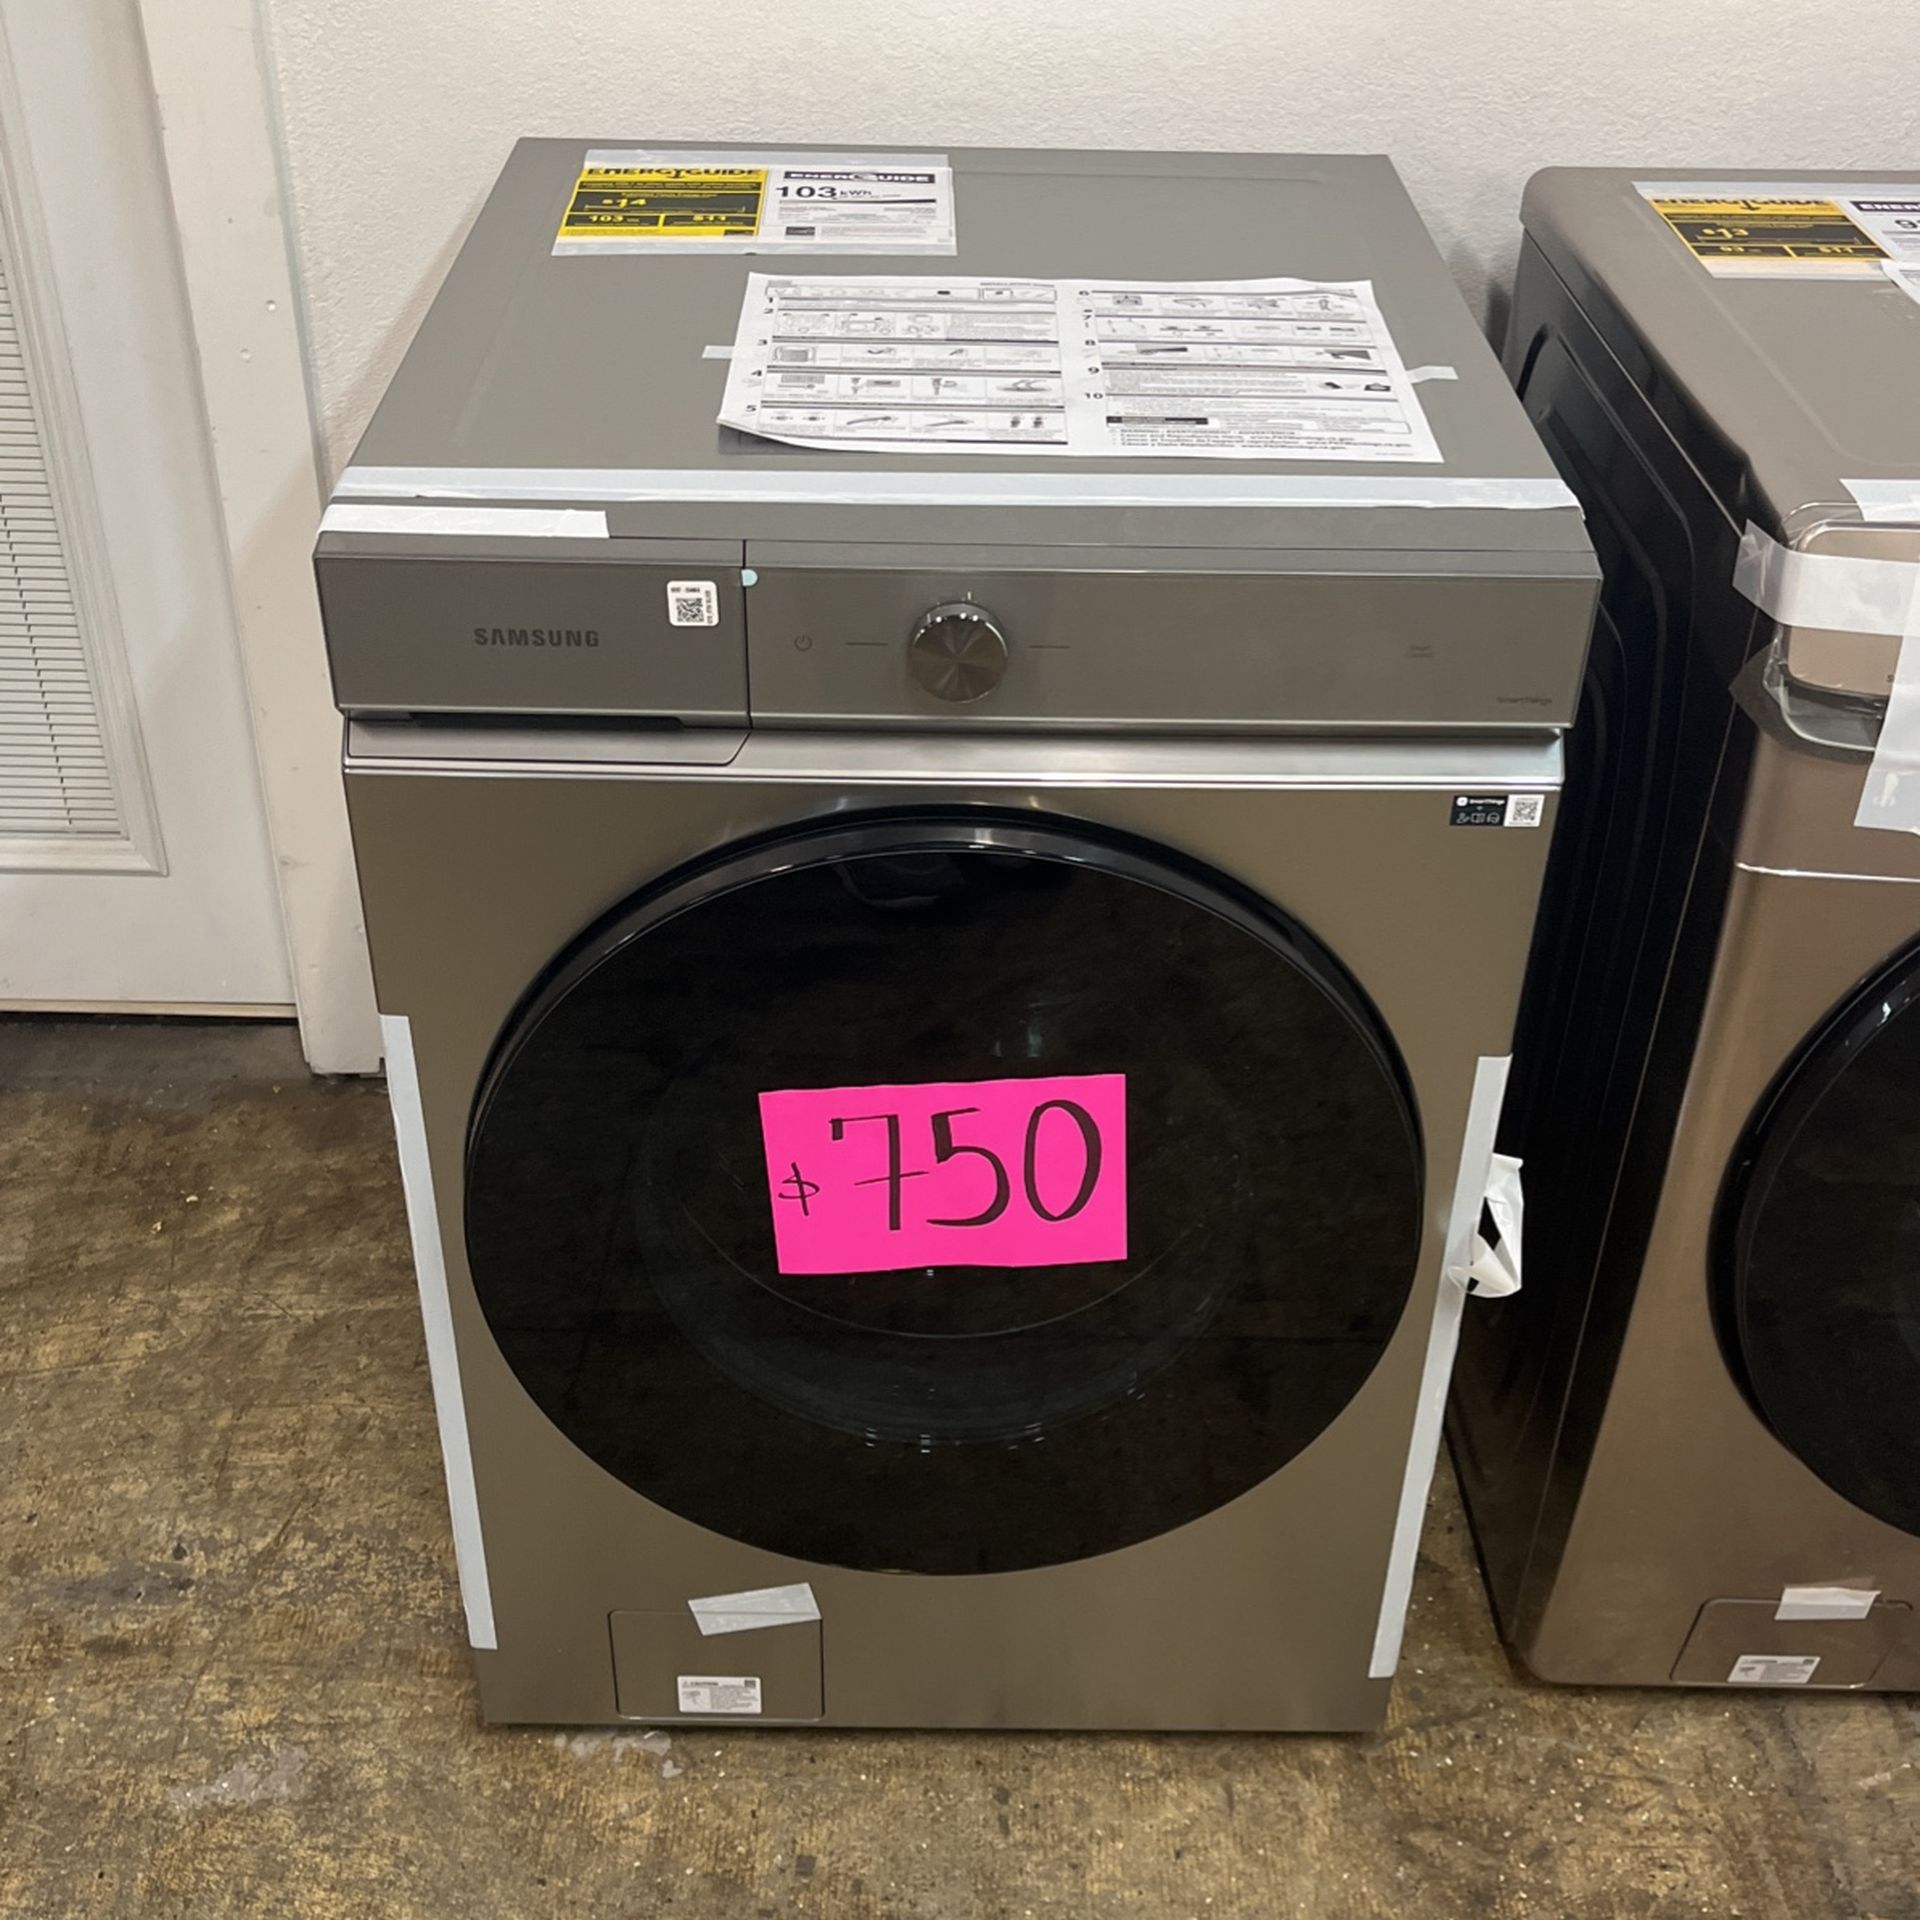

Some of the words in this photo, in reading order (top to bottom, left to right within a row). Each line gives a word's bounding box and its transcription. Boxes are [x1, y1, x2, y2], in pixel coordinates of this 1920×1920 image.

[776, 186, 837, 199] 103
[473, 627, 600, 648] SAMSUNG
[777, 1099, 1103, 1231] $750
